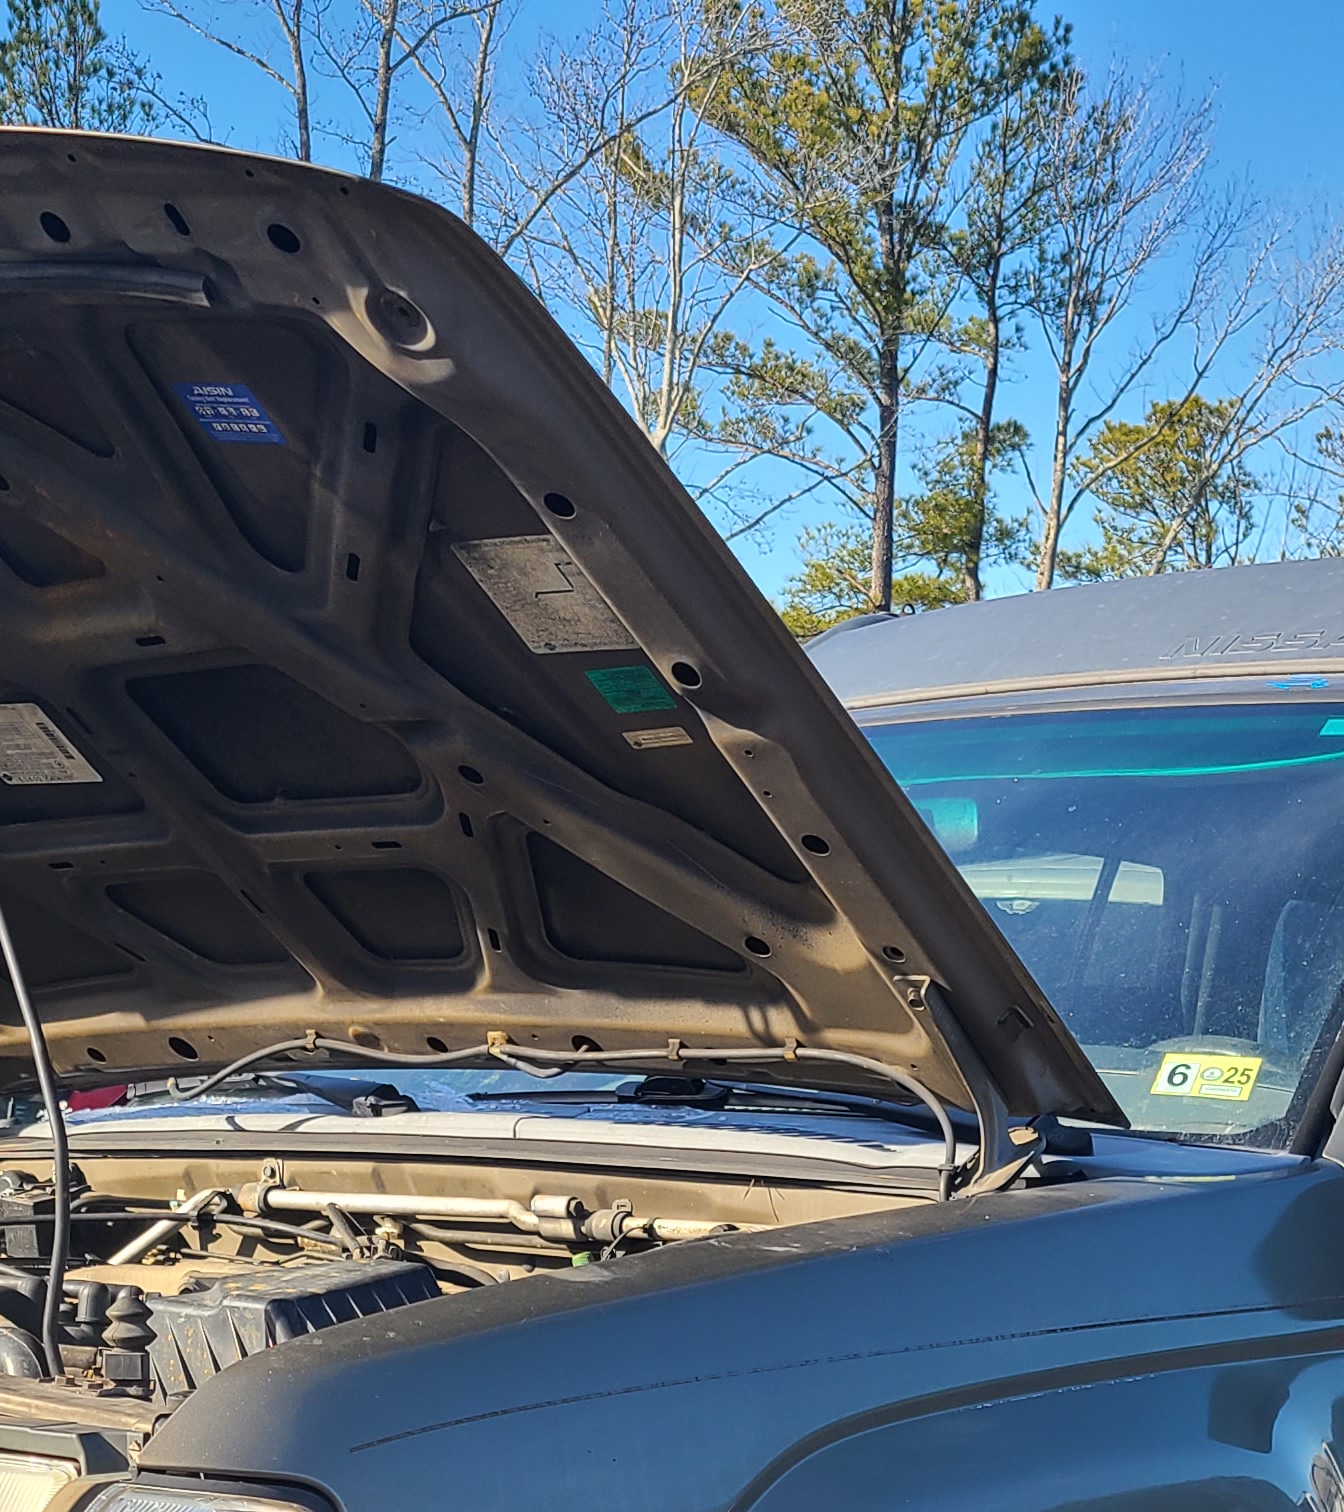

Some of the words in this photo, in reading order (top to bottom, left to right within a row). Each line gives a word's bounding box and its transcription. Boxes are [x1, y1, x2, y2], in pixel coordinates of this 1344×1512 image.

[193, 386, 233, 396] AISIN
[1167, 1063, 1192, 1087] 6
[1222, 1066, 1254, 1086] 25
